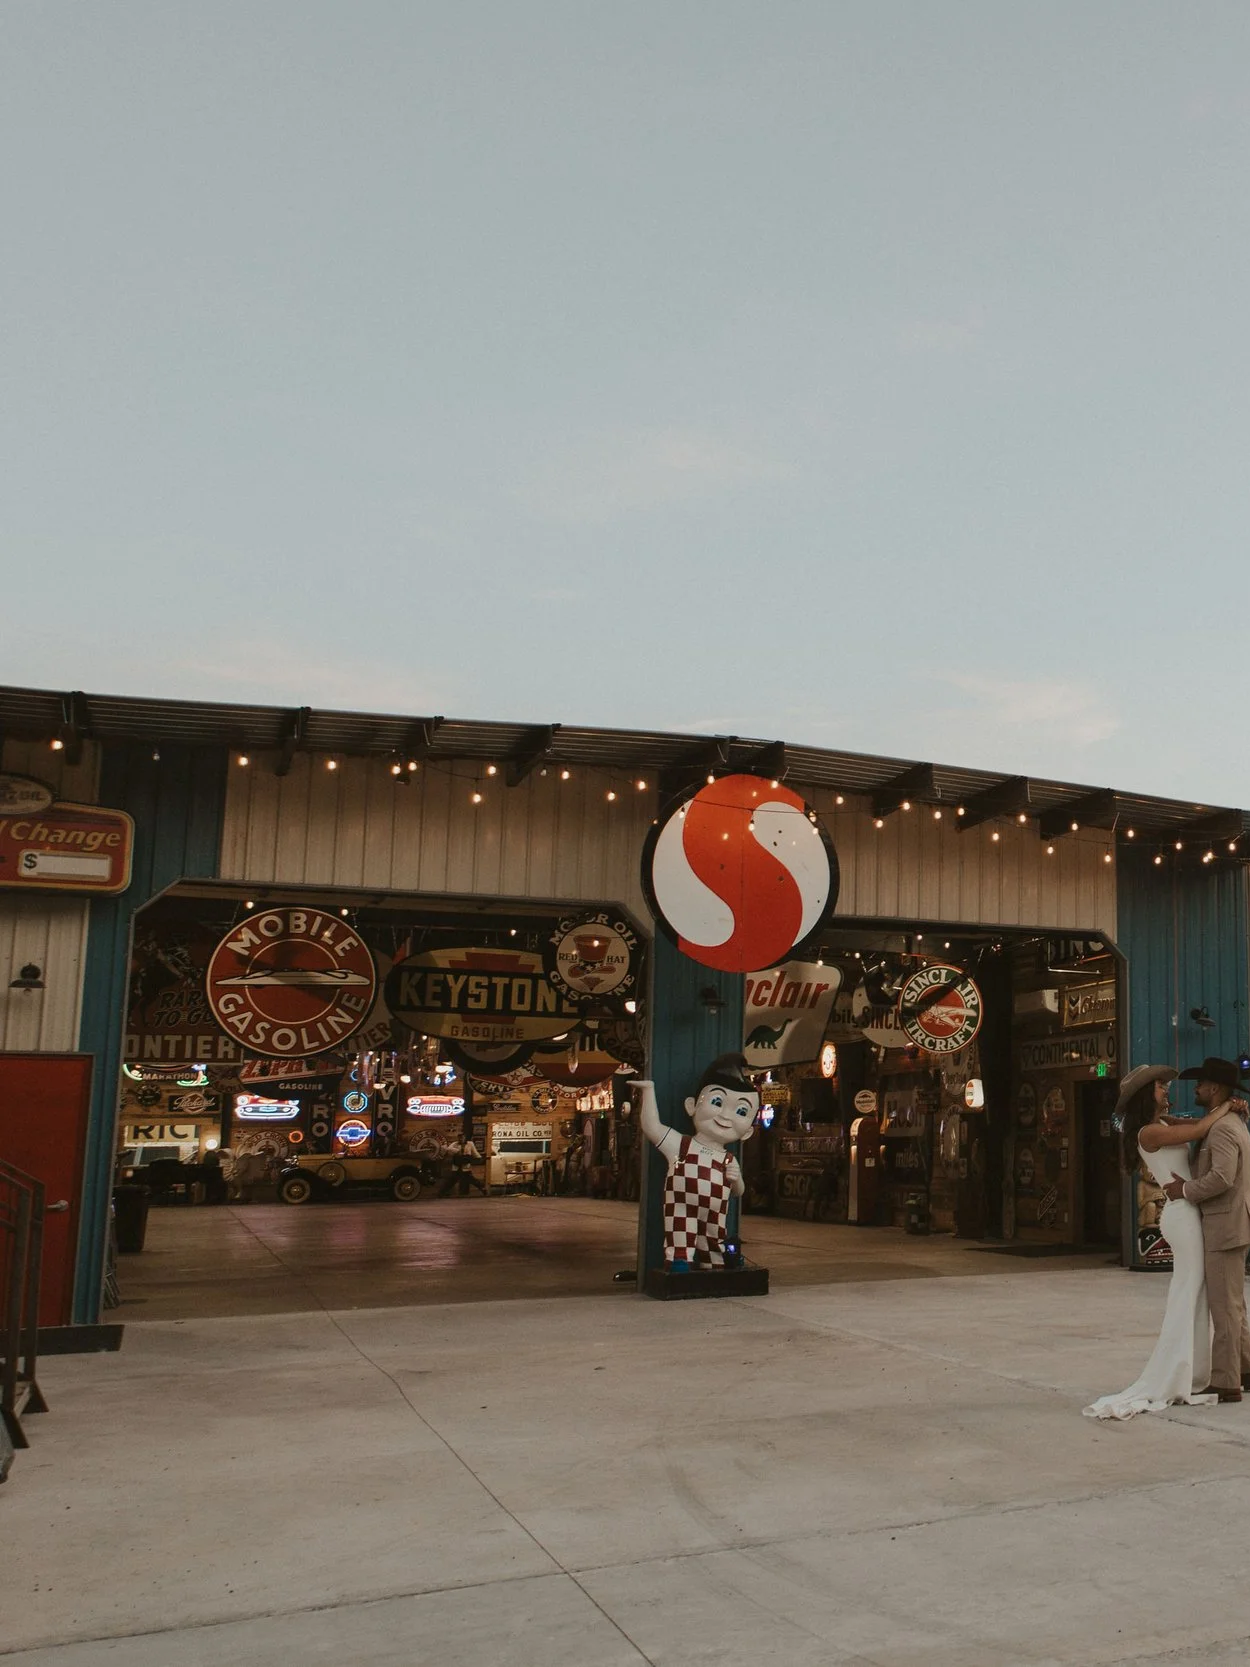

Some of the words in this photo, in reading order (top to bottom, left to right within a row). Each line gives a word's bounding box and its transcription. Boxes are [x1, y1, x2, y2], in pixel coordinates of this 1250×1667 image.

[10, 821, 121, 852] Change
[225, 912, 359, 957] MOBILE
[549, 913, 609, 946] MOR
[613, 921, 638, 950] OIL
[558, 952, 578, 961] RED
[606, 955, 626, 964] HAT
[549, 970, 636, 1001] GASONE
[218, 992, 366, 1051] GASOLINE
[451, 1025, 524, 1038] GASOLINE
[906, 1019, 976, 1051] IRCRAFT
[143, 1072, 198, 1081] MARATHON
[278, 1083, 323, 1091] GASOLINE
